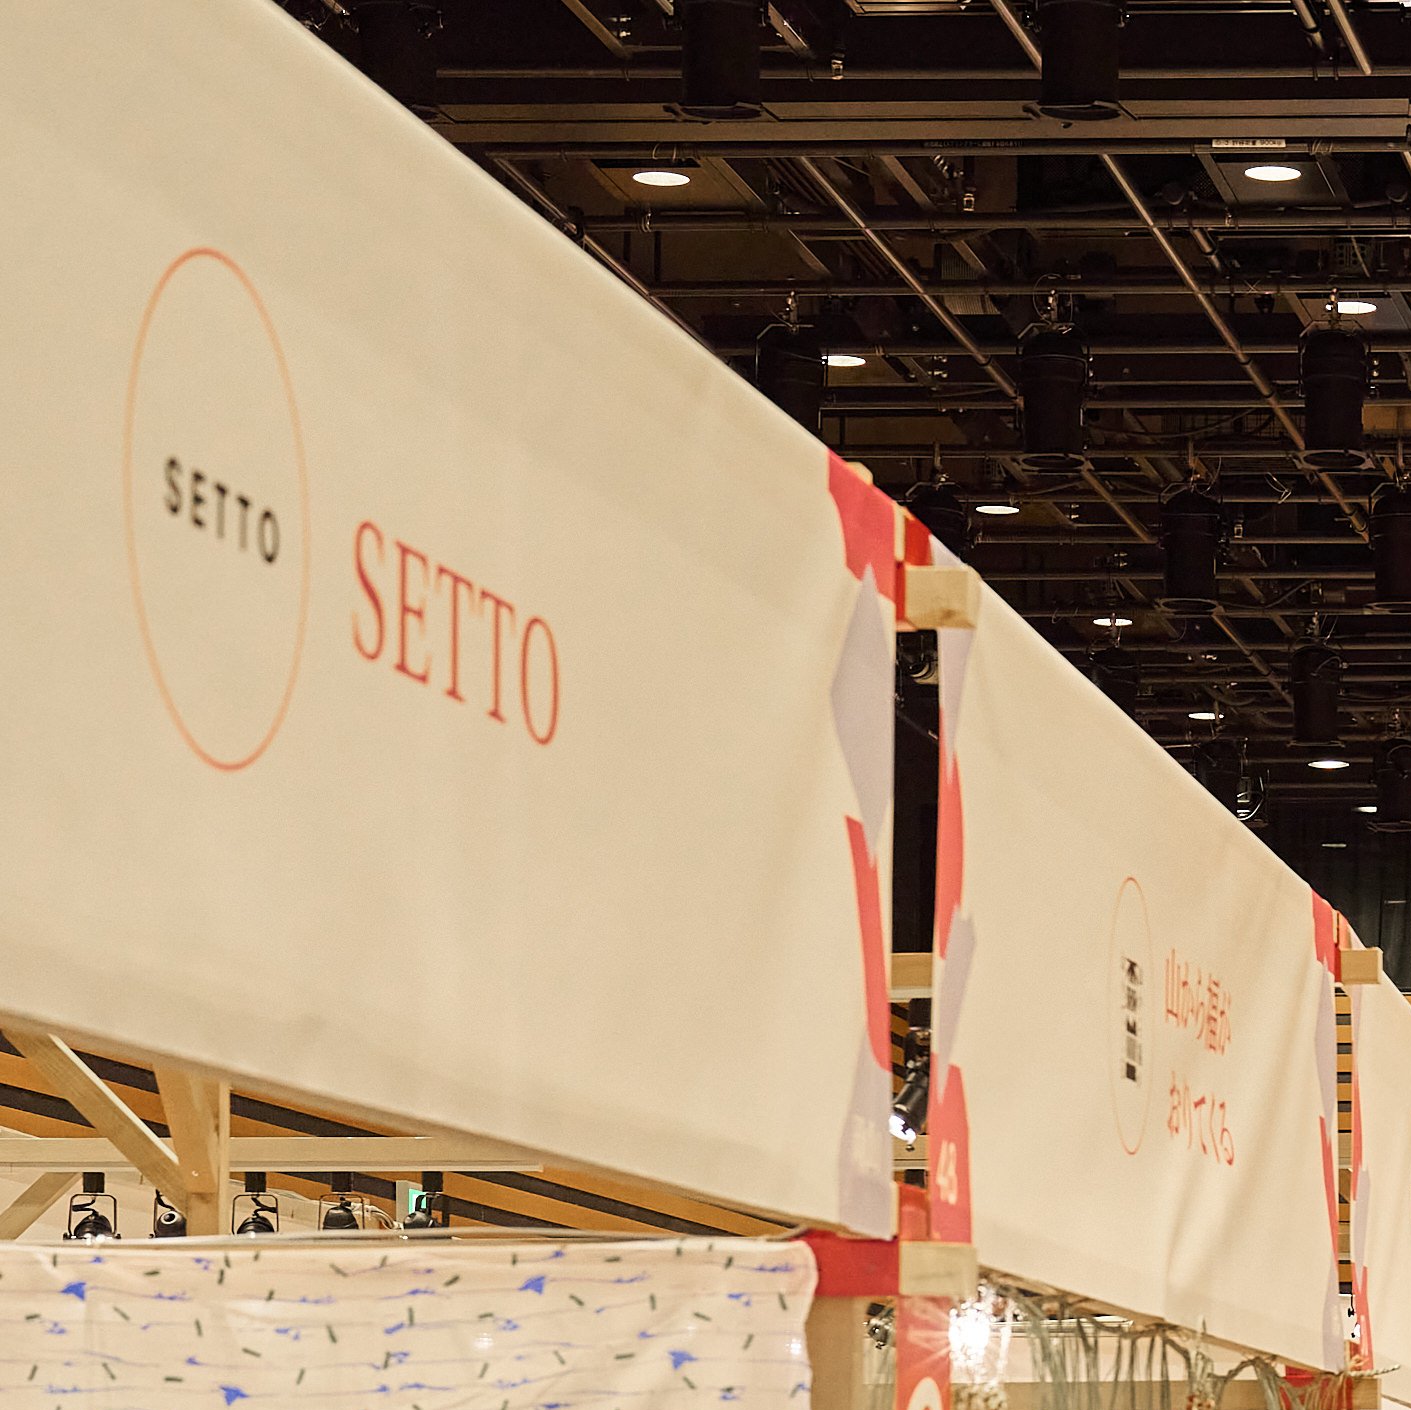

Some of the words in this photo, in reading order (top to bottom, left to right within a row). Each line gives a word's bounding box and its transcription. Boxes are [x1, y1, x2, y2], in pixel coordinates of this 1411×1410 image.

[163, 456, 281, 566] SETTO
[351, 518, 561, 746] SETTO
[1168, 1069, 1236, 1167] おりてくる
